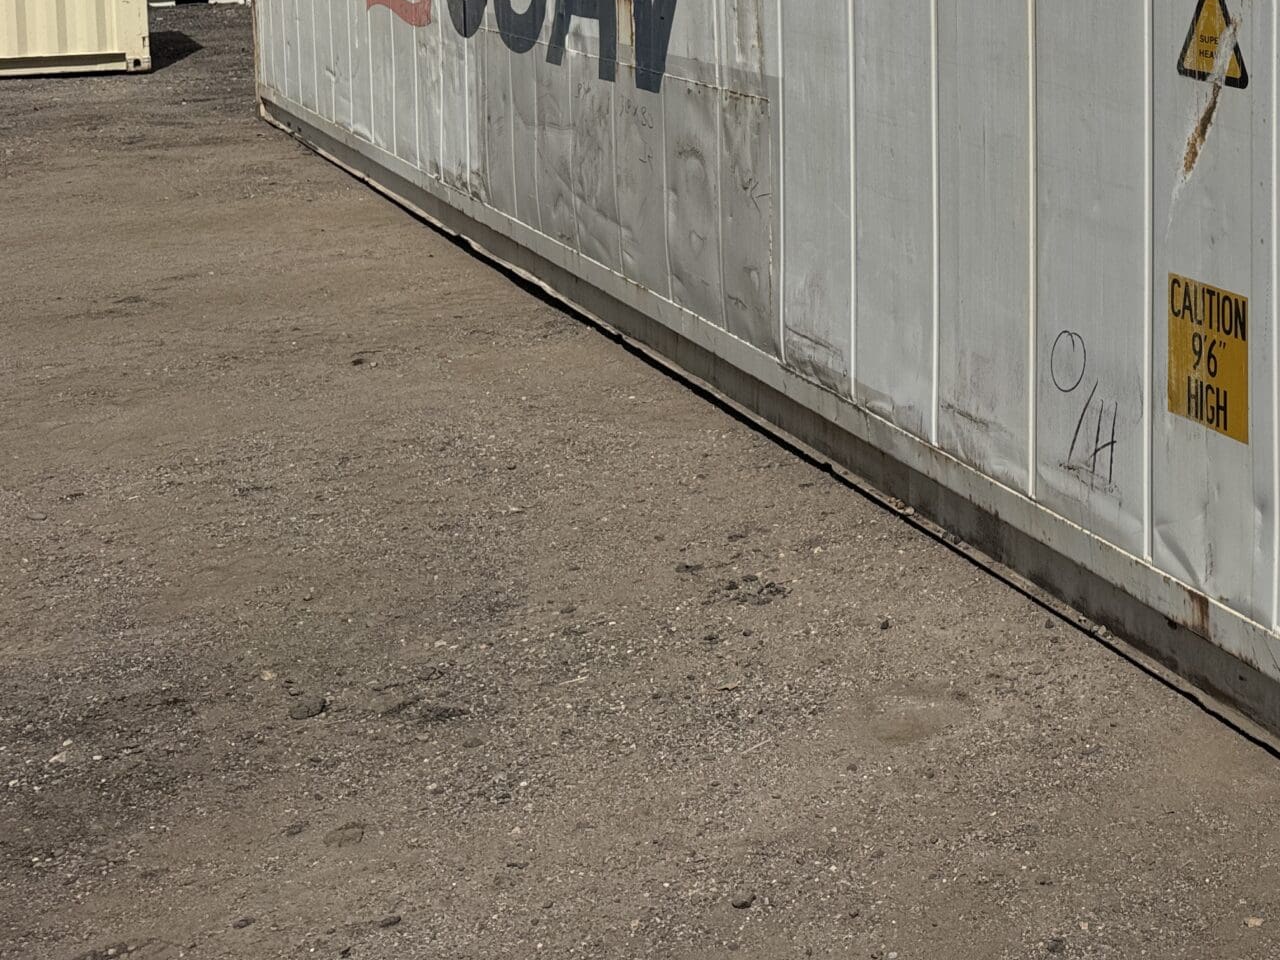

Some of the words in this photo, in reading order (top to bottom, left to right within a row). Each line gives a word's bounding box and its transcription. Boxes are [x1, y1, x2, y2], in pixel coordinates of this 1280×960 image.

[1198, 49, 1217, 59] HEA
[1199, 34, 1220, 45] SUPE
[1170, 277, 1247, 341] CAUTION
[1187, 376, 1228, 431] HIGH
